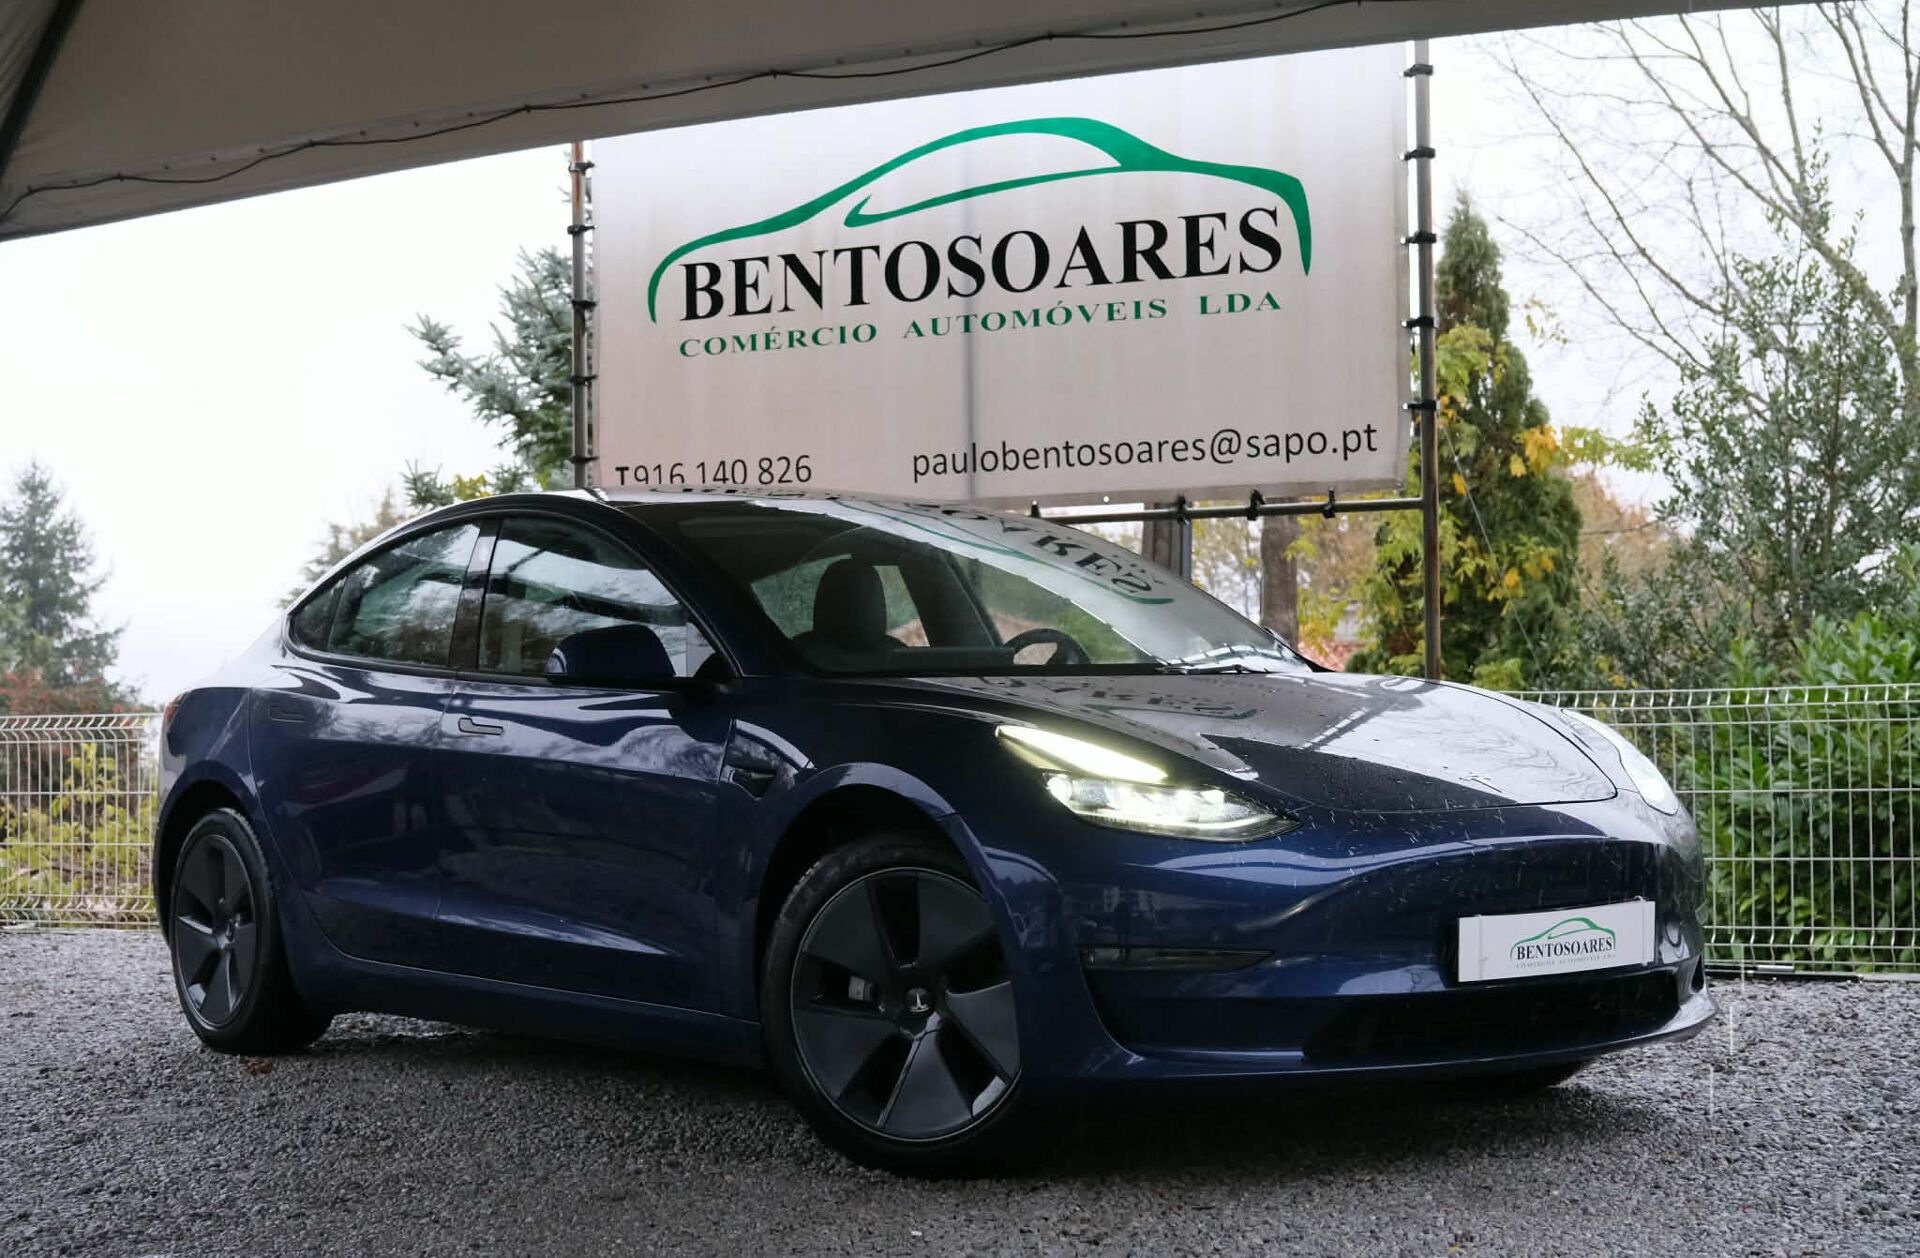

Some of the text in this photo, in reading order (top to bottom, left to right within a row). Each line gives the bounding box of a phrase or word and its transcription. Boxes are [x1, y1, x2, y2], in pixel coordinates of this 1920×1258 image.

[679, 206, 1283, 322] BENTOSOARES
[679, 290, 1282, 358] COMÉRCIO AUTOMÓVEIS LDA
[696, 458, 748, 485] 140
[757, 454, 812, 485] 826
[912, 422, 1379, 484] paulobentosoares@sapo.pt
[1517, 937, 1612, 960] BENTOSOARES
